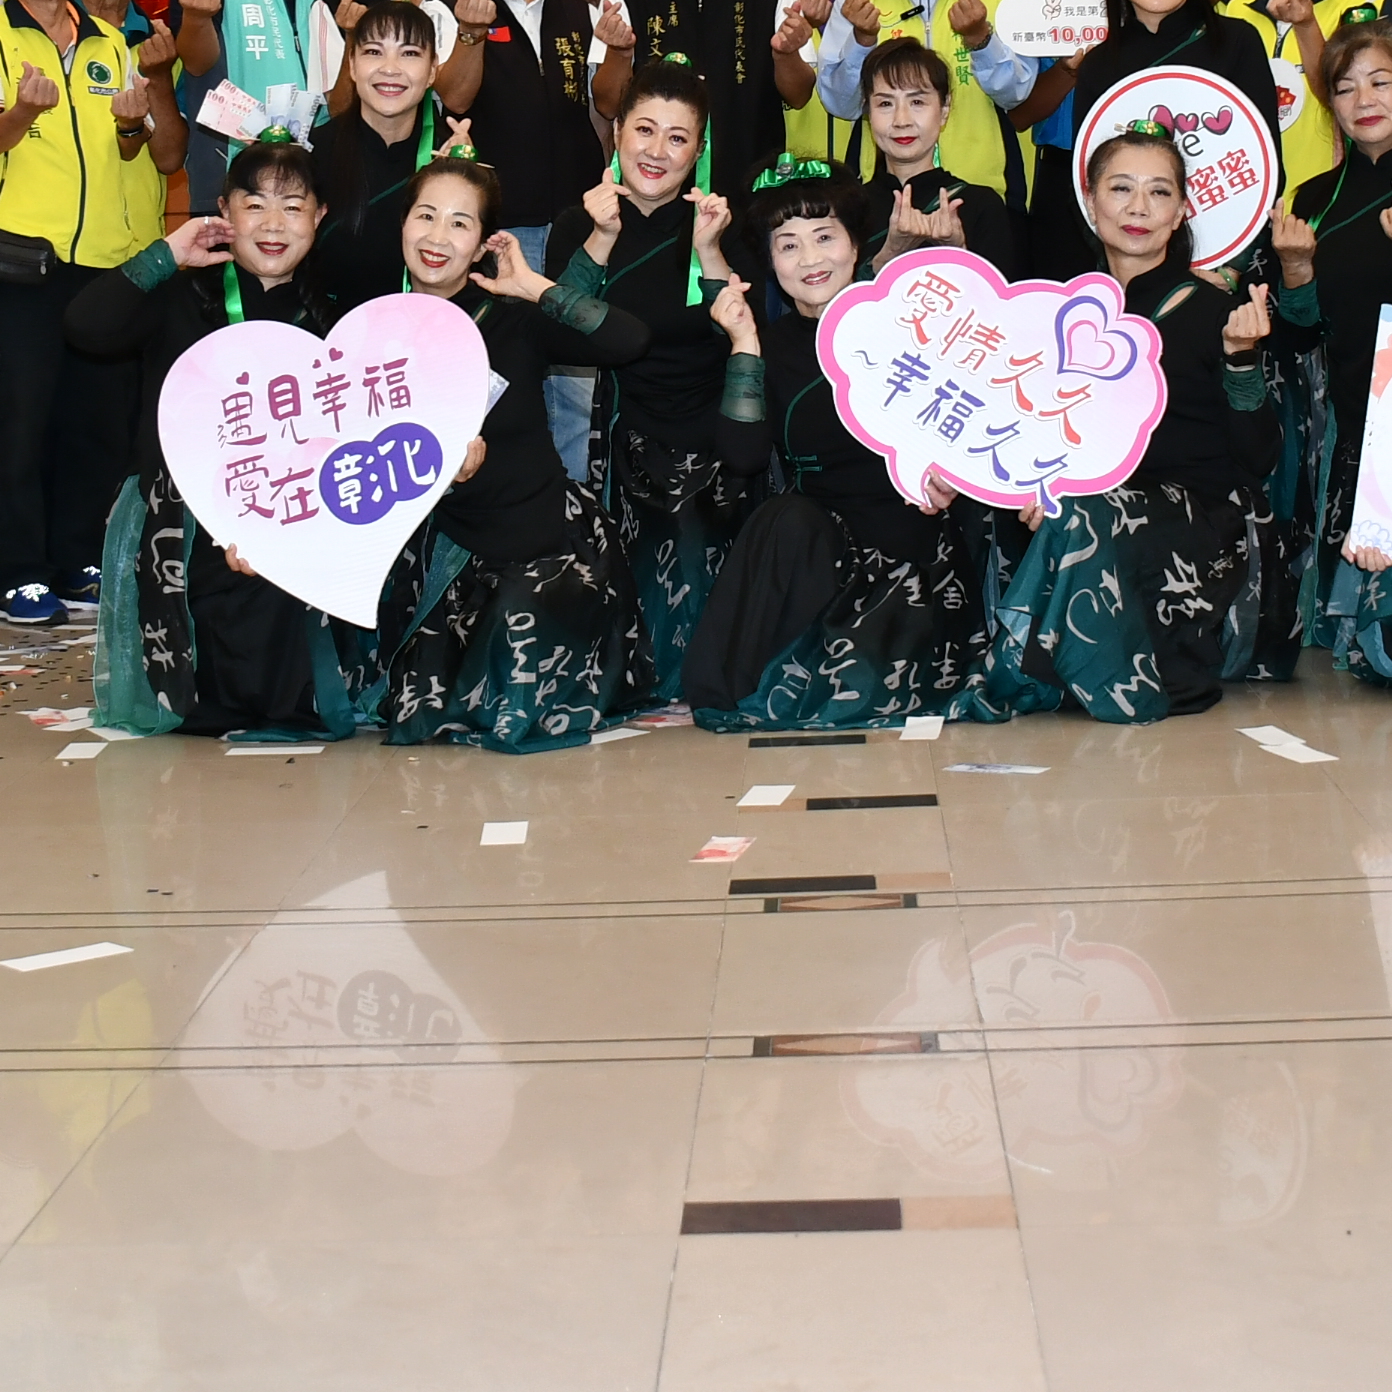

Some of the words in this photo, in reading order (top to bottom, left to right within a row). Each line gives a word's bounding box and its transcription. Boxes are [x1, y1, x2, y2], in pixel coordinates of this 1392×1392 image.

[241, 3, 269, 60] 周平
[668, 1, 679, 27] 主席
[1183, 148, 1260, 222] 蜜蜜
[899, 271, 1093, 445] 愛情久久
[217, 357, 412, 448] 遇見幸福
